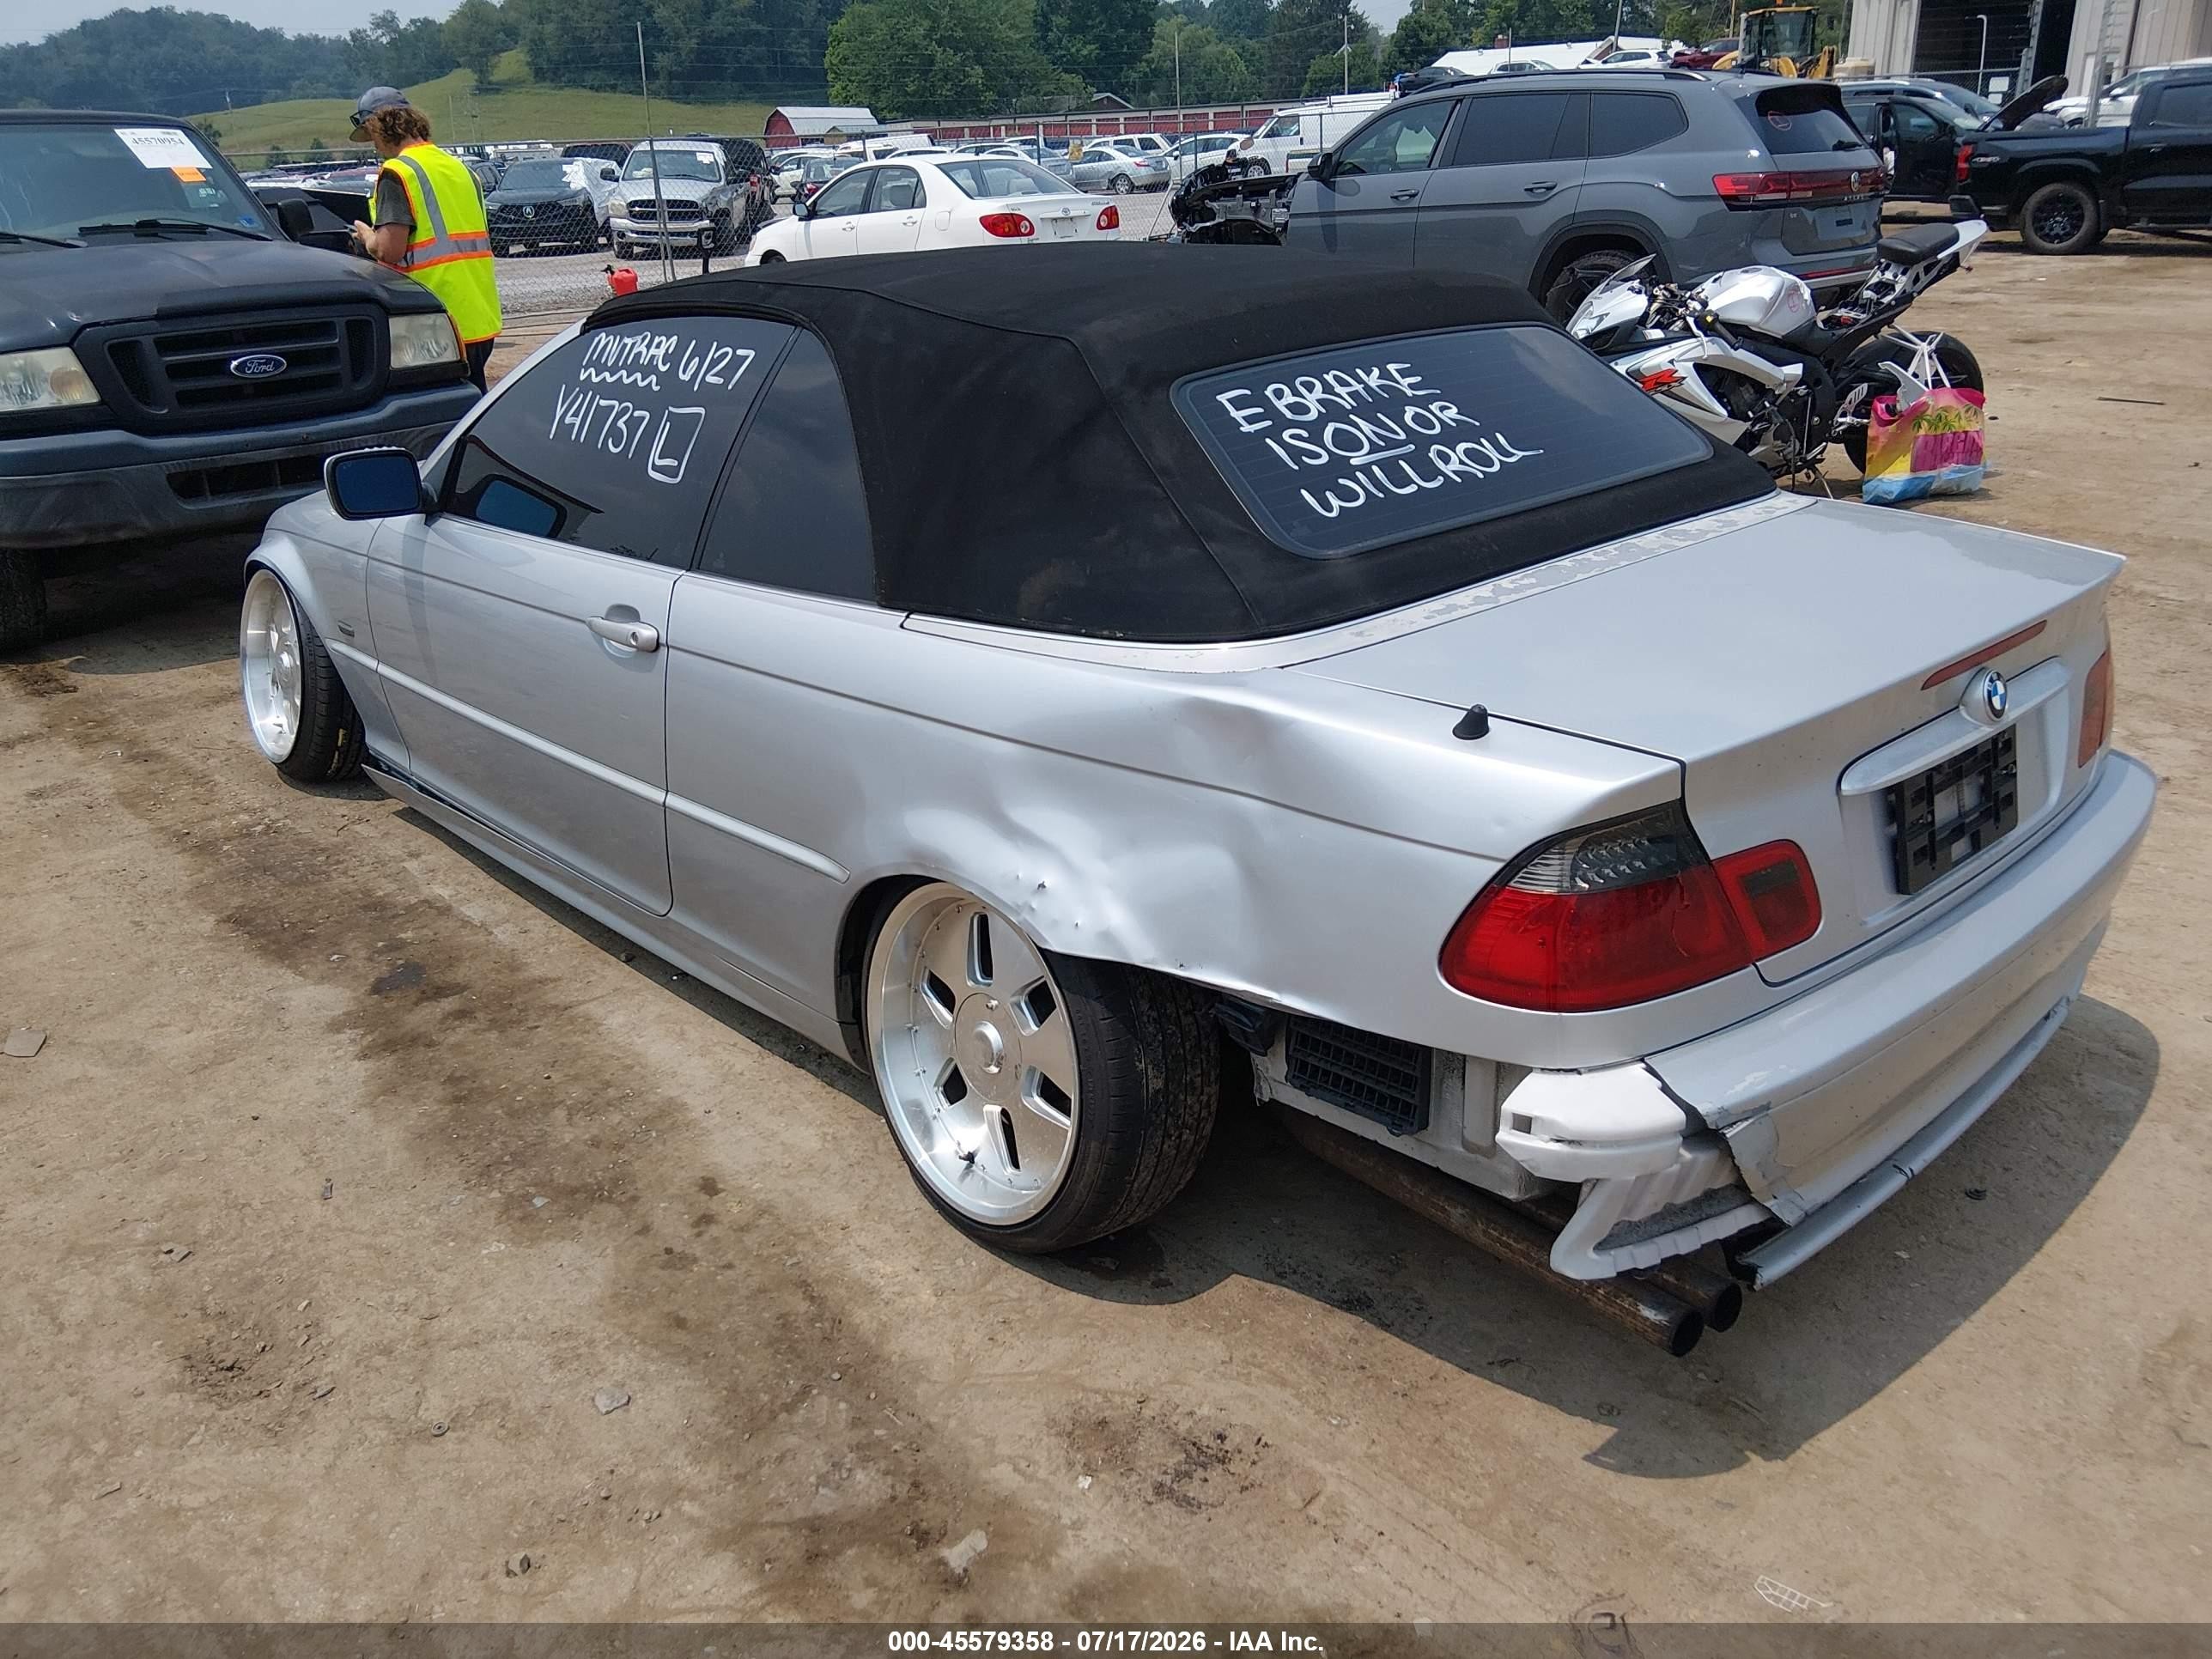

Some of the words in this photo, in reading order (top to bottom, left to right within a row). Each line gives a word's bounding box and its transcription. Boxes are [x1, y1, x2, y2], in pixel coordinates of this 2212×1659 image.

[245, 359, 275, 374] Ford
[678, 339, 756, 392] 6/27
[549, 383, 651, 459] Y41737
